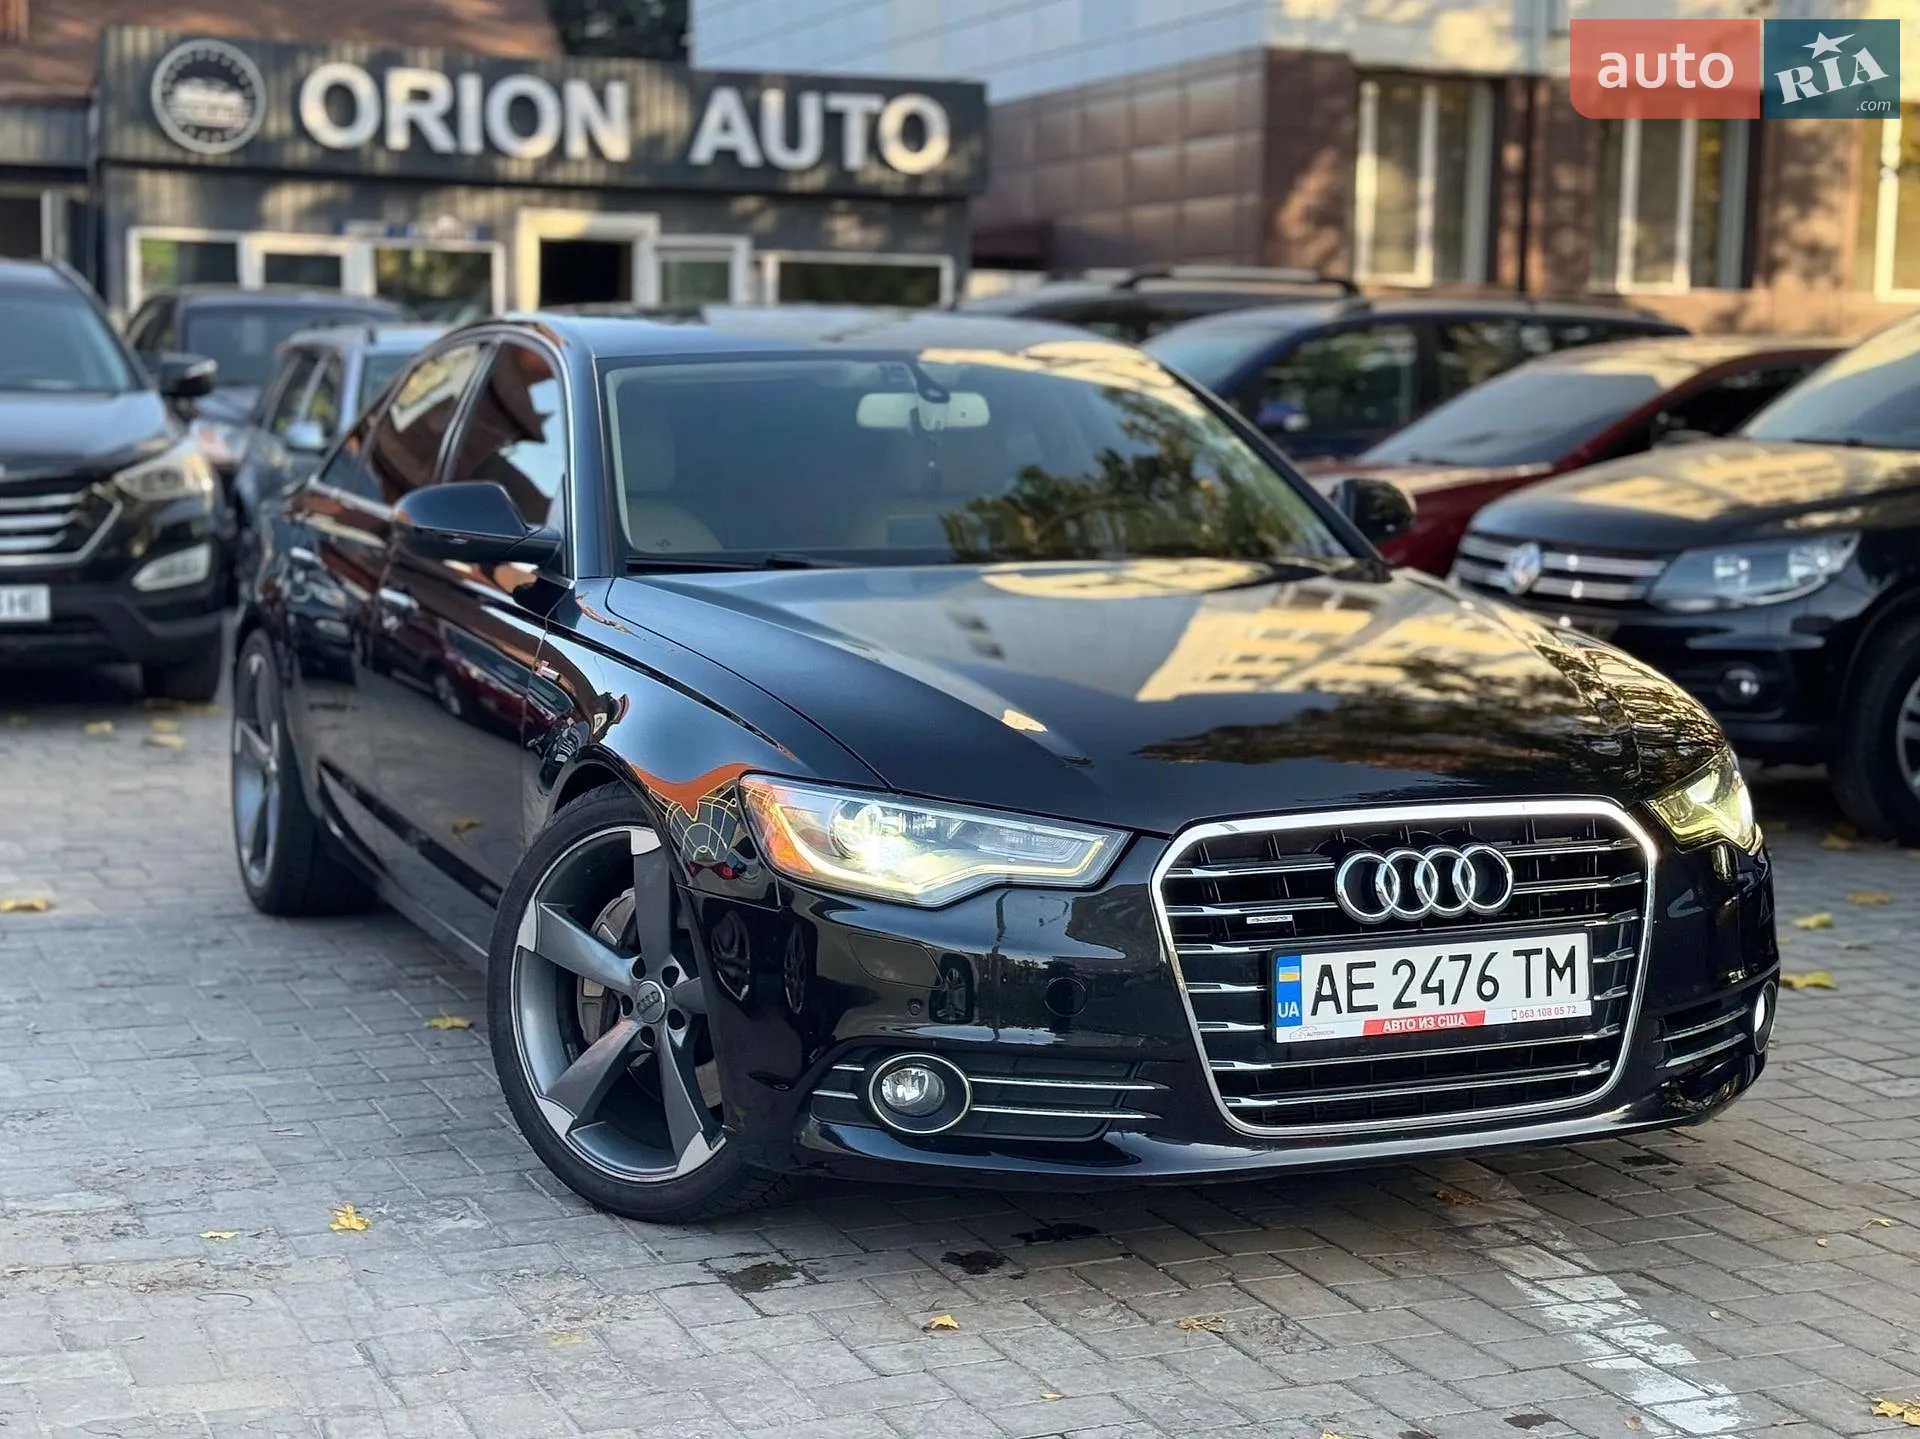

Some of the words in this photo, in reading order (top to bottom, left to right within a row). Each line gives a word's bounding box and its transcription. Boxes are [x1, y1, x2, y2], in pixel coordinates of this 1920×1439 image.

[299, 61, 631, 162] ORION
[688, 85, 950, 175] AUTO
[1310, 961, 1379, 1017] AE
[1391, 951, 1500, 1010] 2476
[1512, 945, 1577, 999] TM
[1277, 1000, 1300, 1018] UA
[1519, 1009, 1535, 1019] 063
[1567, 1005, 1577, 1014] 72
[1382, 1019, 1416, 1033] АВТО
[1418, 1017, 1435, 1029] ИЗ
[1437, 1014, 1467, 1027] США
